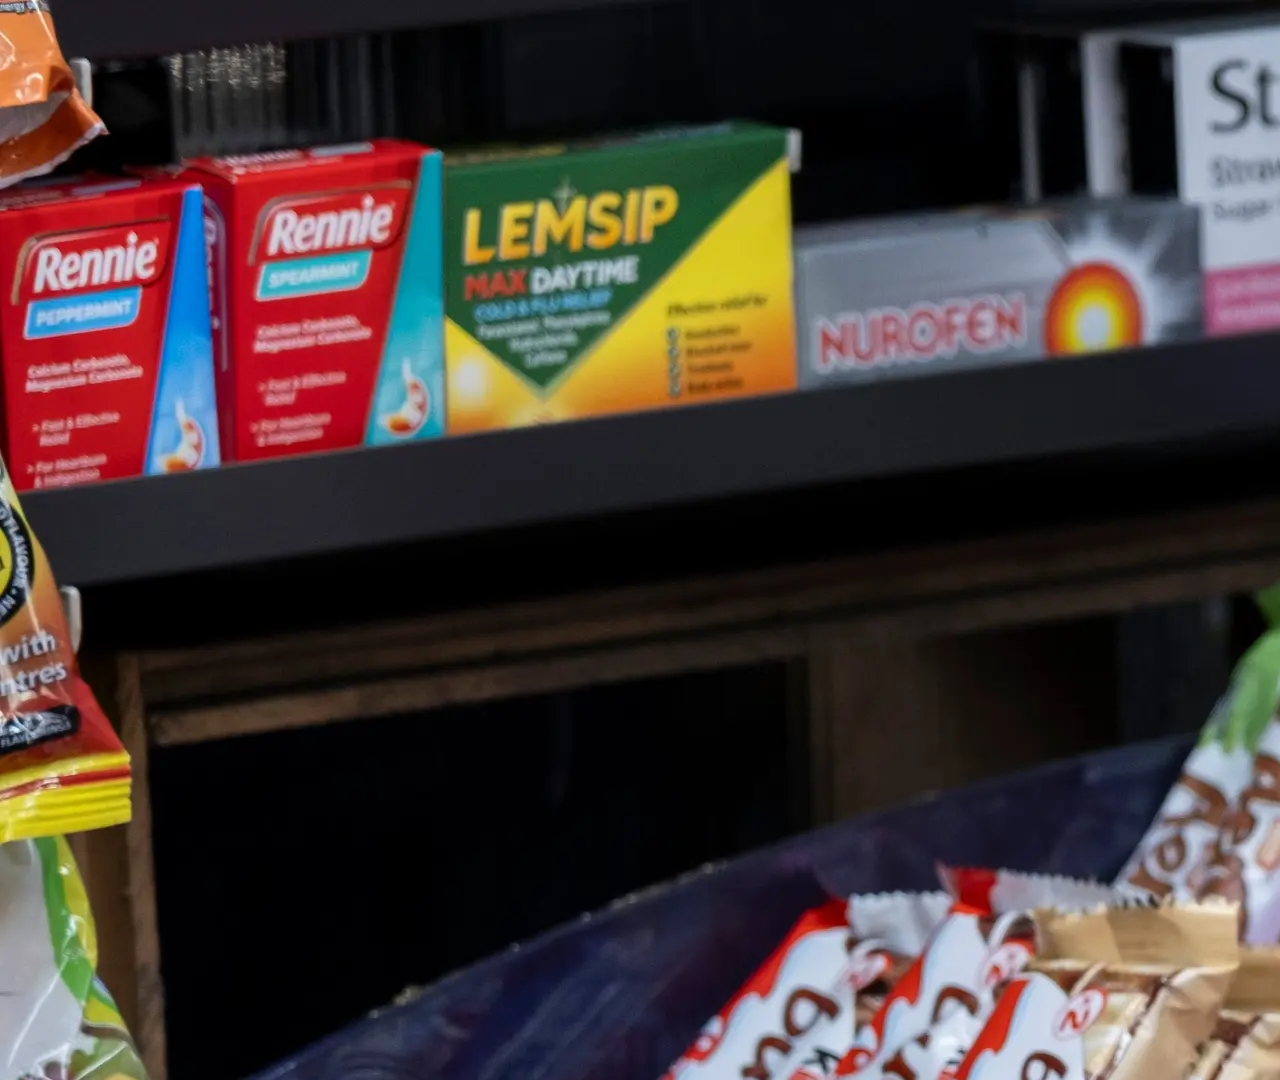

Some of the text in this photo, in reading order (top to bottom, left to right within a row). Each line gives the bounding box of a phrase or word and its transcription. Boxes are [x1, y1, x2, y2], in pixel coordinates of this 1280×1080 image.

[267, 193, 395, 257] Rennie
[464, 185, 679, 265] LEMSIP
[33, 231, 159, 293] Rennie
[268, 260, 359, 288] SPEARMINT
[464, 256, 639, 299] MAX DAYTIME
[35, 299, 133, 327] PEPPERMINT
[817, 296, 1023, 368] NUROFEN
[0, 631, 55, 664] with
[0, 663, 67, 694] ntres
